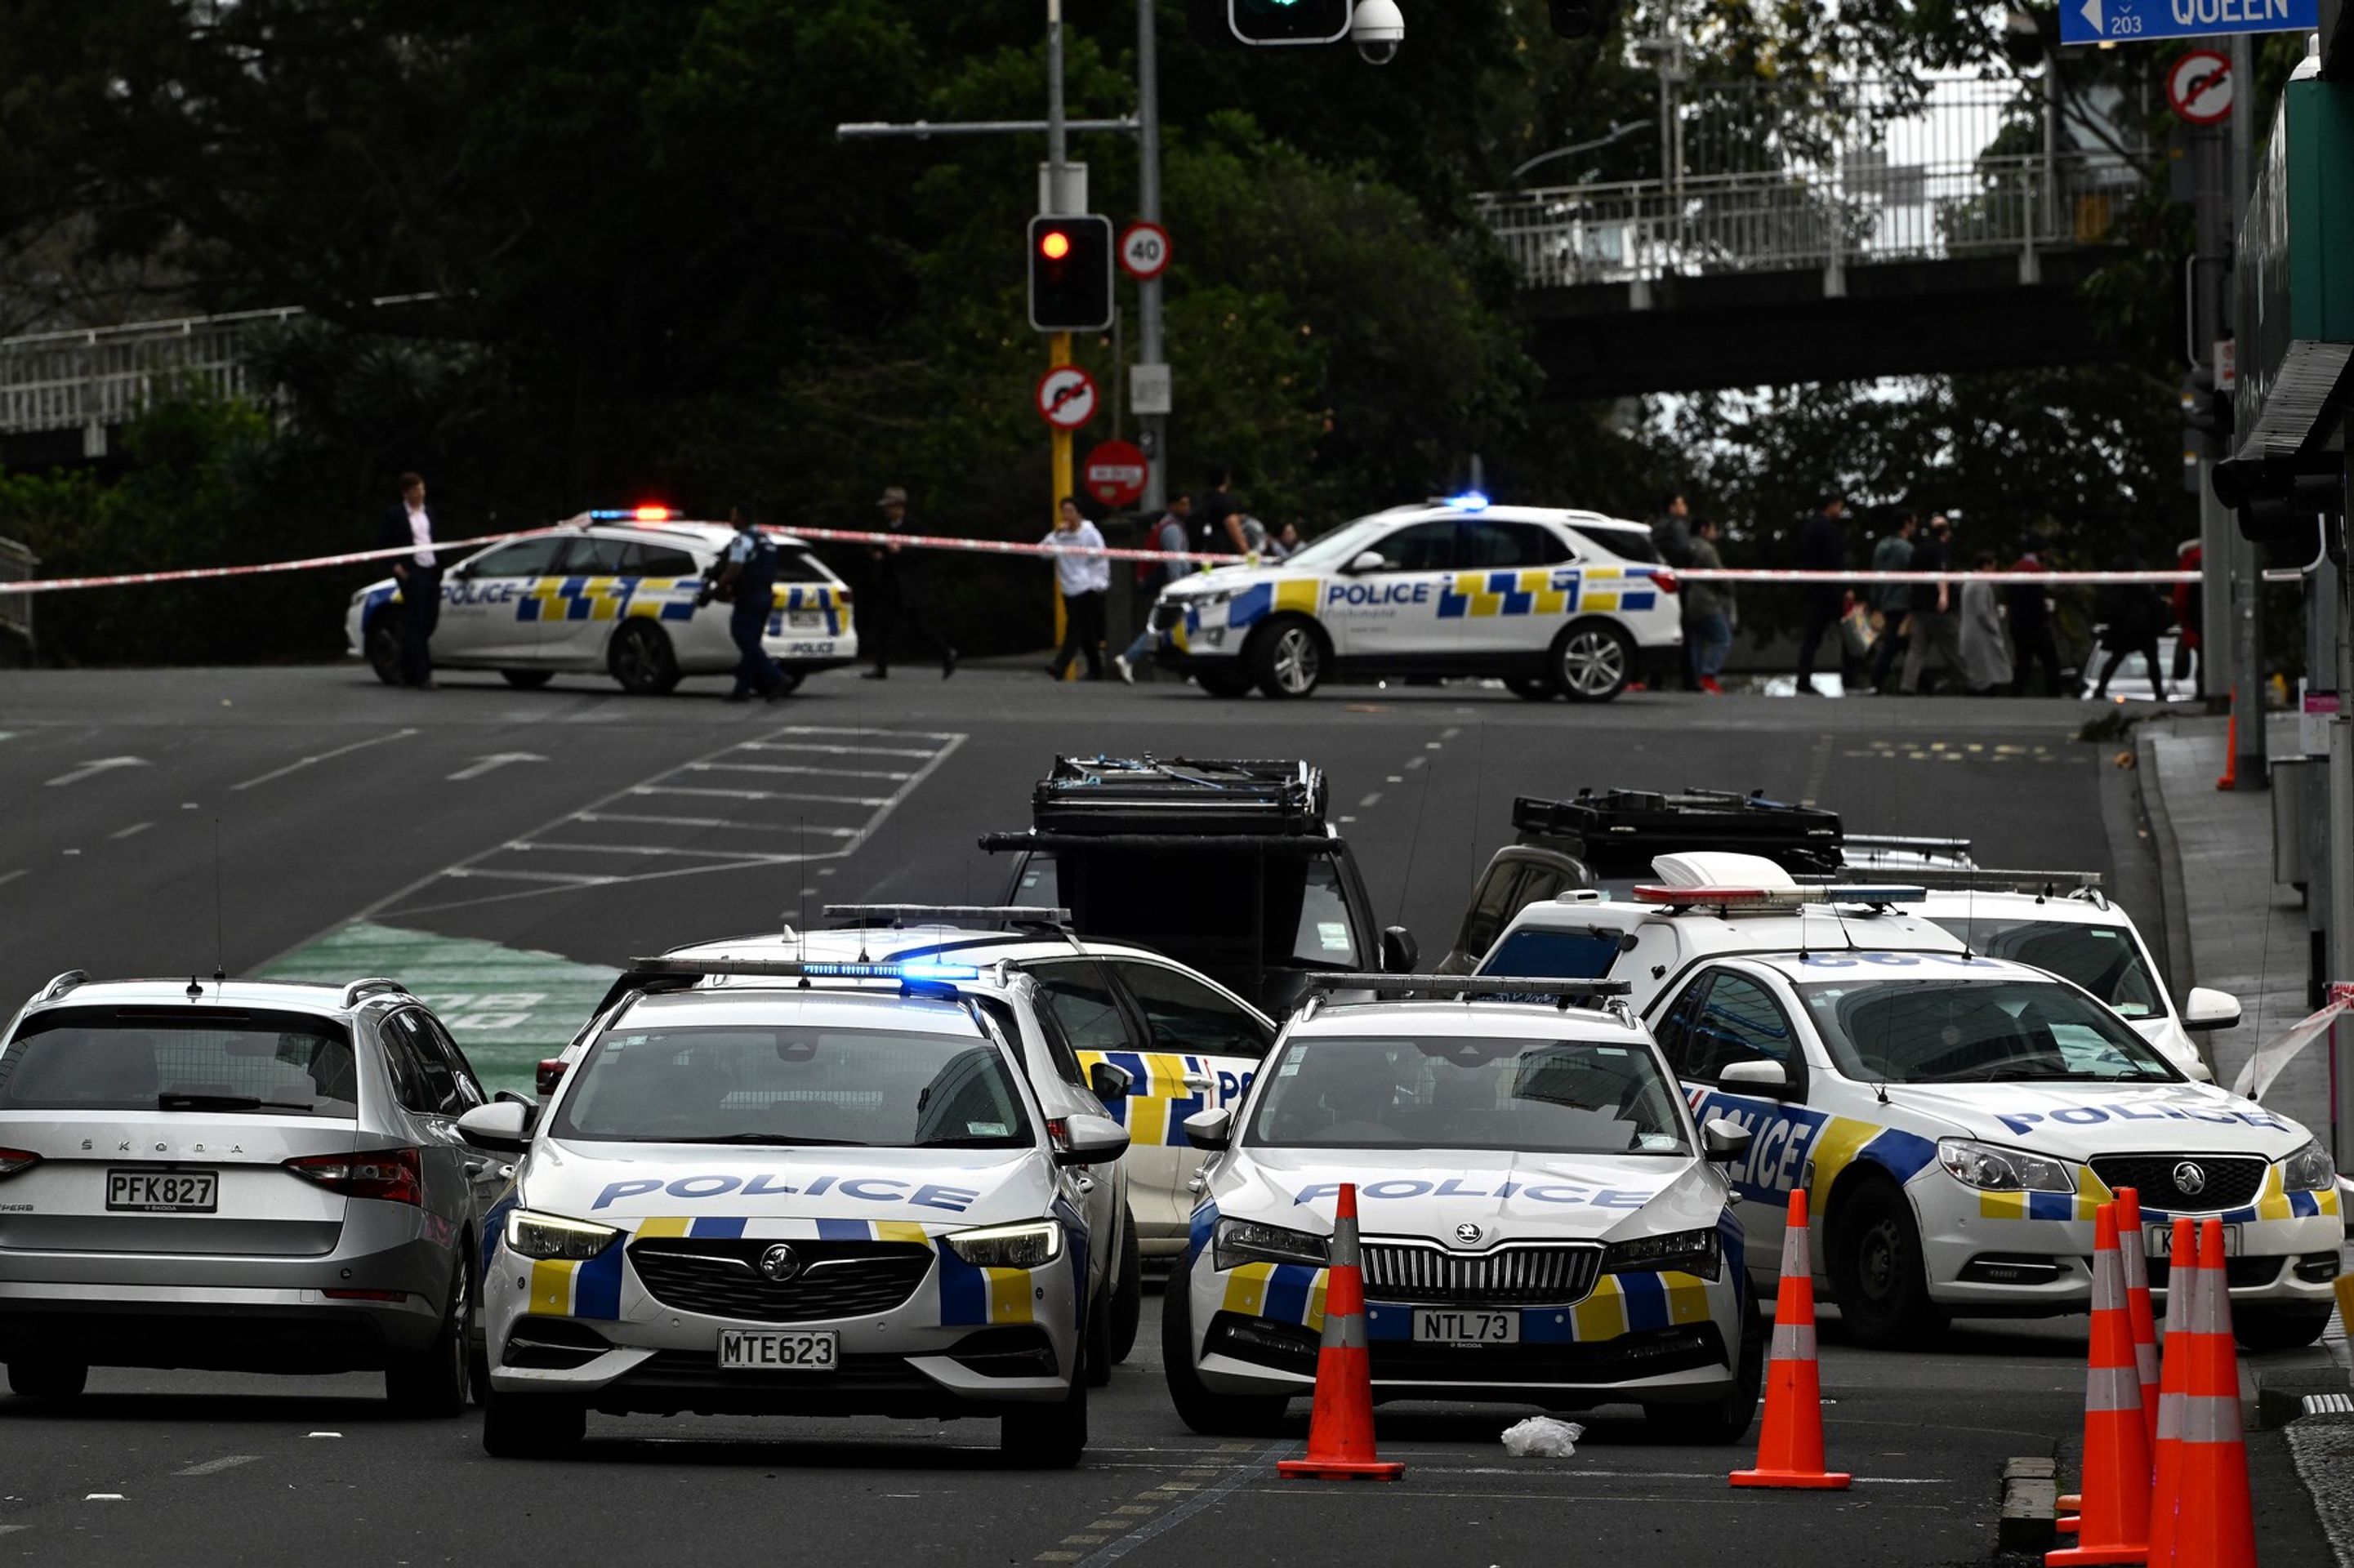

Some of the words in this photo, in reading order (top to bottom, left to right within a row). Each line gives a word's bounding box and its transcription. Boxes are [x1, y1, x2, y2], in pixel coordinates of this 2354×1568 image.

[2111, 16, 2142, 34] 203
[1130, 240, 1160, 261] 40
[1328, 583, 1429, 605] POLICE
[1994, 1103, 2290, 1135] POLICE
[111, 1177, 212, 1204] PFK827
[591, 1174, 980, 1212] POLICE
[1294, 1178, 1654, 1209] POLICE
[1425, 1314, 1508, 1340] NTL73
[724, 1338, 832, 1365] MTE623
